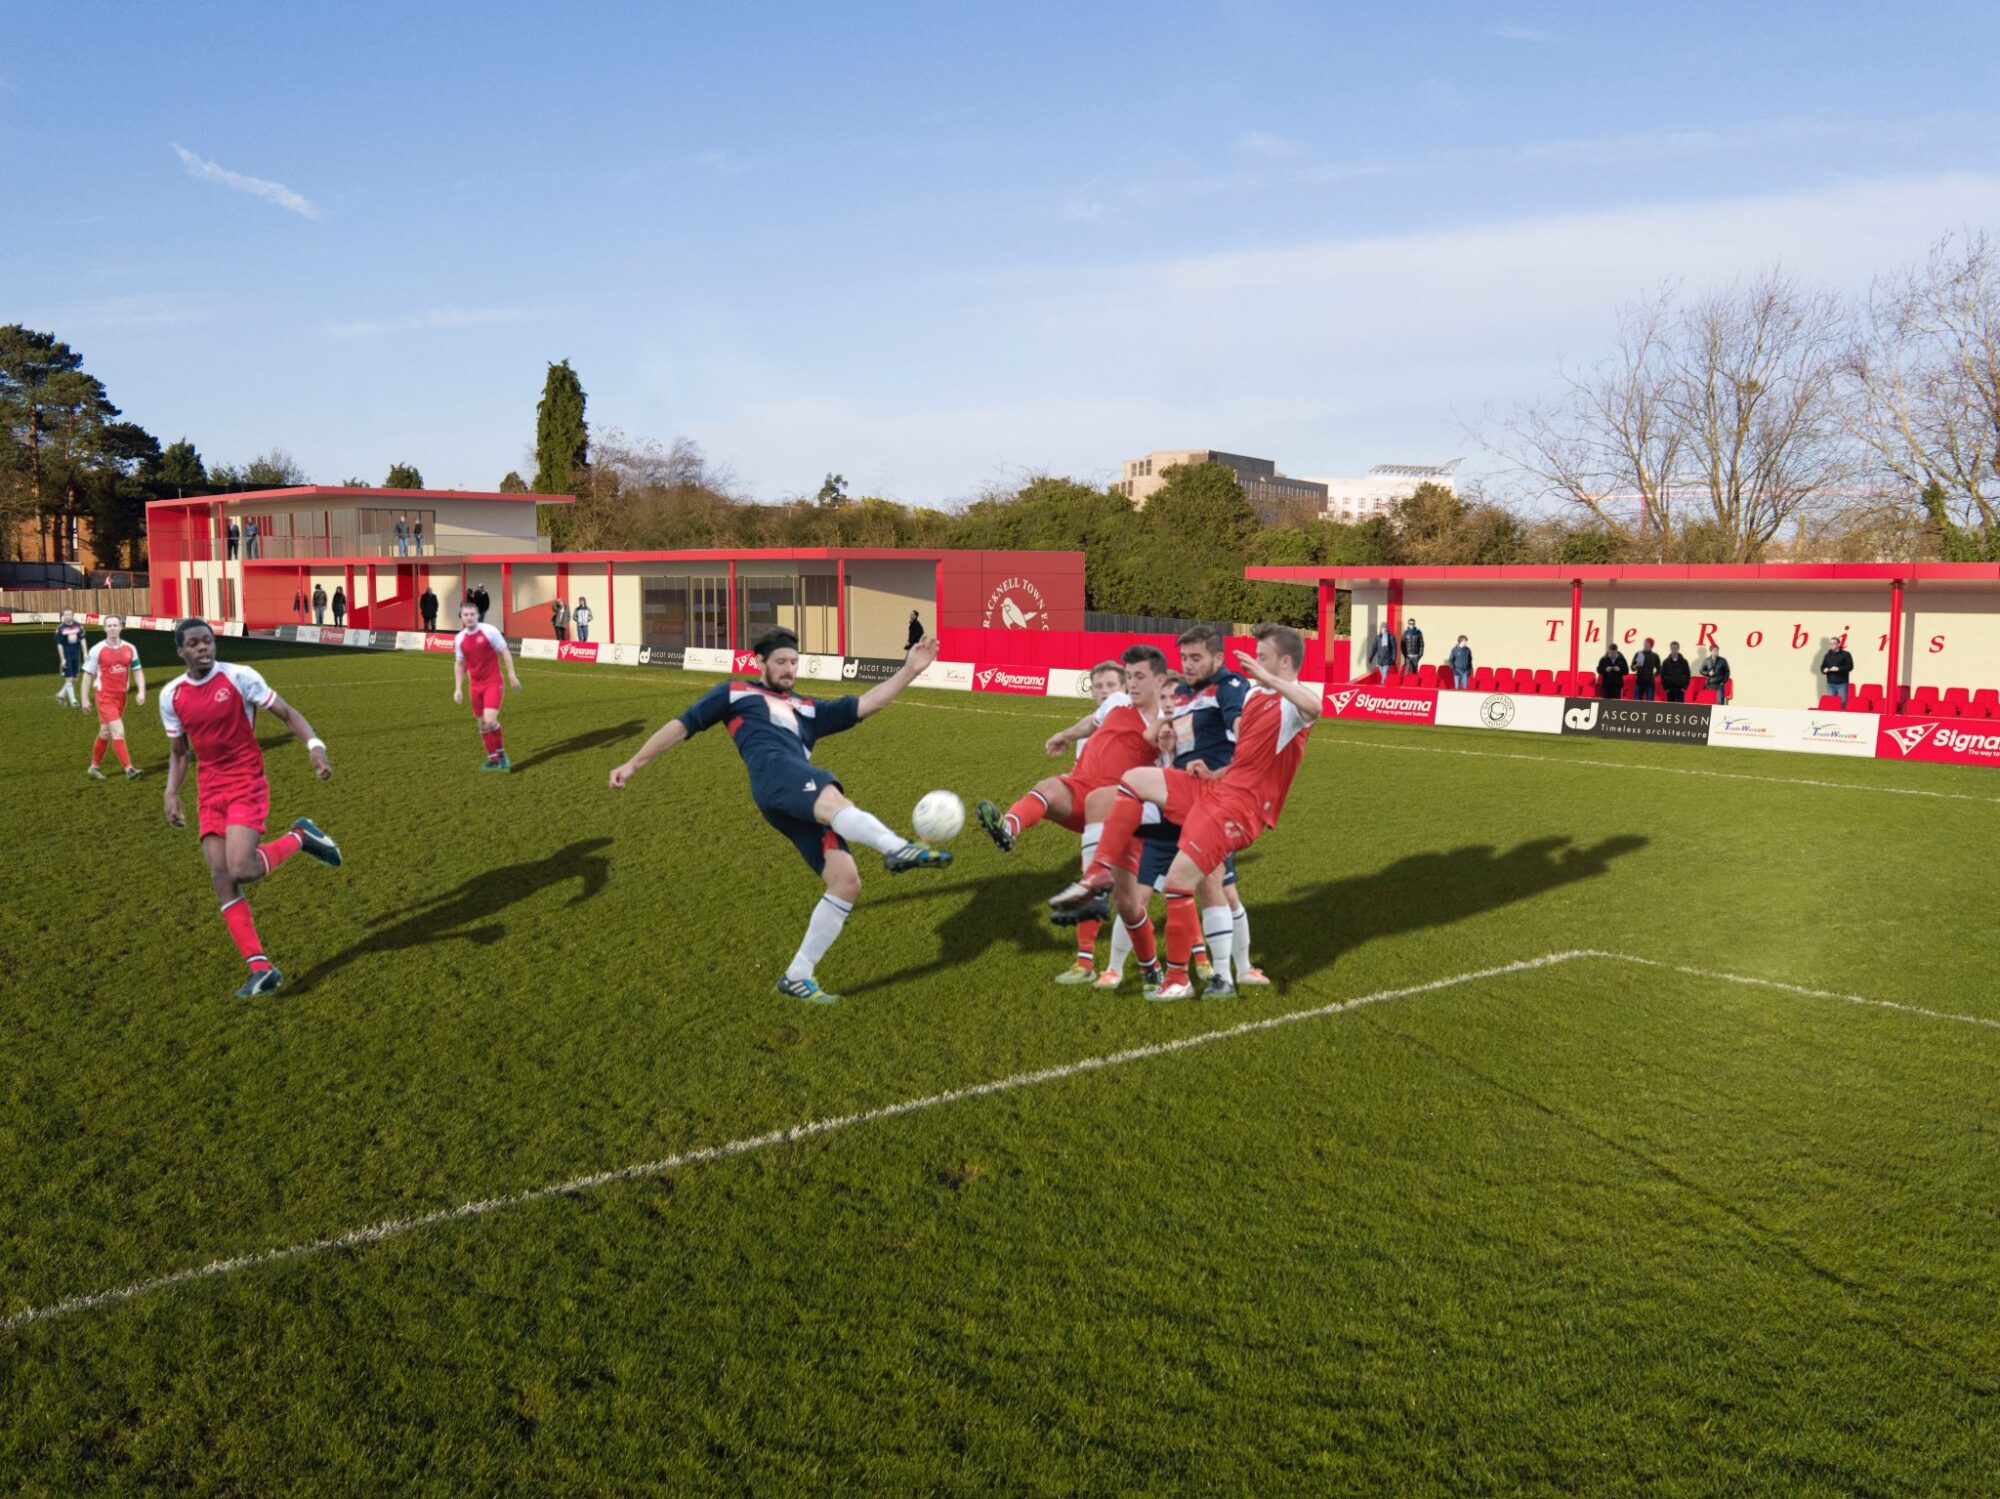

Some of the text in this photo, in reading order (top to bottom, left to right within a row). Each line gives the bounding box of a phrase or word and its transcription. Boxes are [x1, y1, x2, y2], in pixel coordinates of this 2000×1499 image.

[983, 577, 1020, 629] RACKNELL
[1022, 578, 1045, 610] TOWN
[1546, 620, 1637, 644] The
[859, 664, 879, 672] ASCOT
[995, 671, 1045, 687] Signarama
[1355, 693, 1433, 712] Signarama
[1482, 695, 1513, 711] GROSVENOR
[1484, 717, 1509, 729] CASINOS
[1602, 710, 1710, 726] ASCOT DESIGN
[1601, 724, 1642, 734] Timeless
[1646, 726, 1707, 738] architecture
[1933, 728, 2000, 752] Signa
